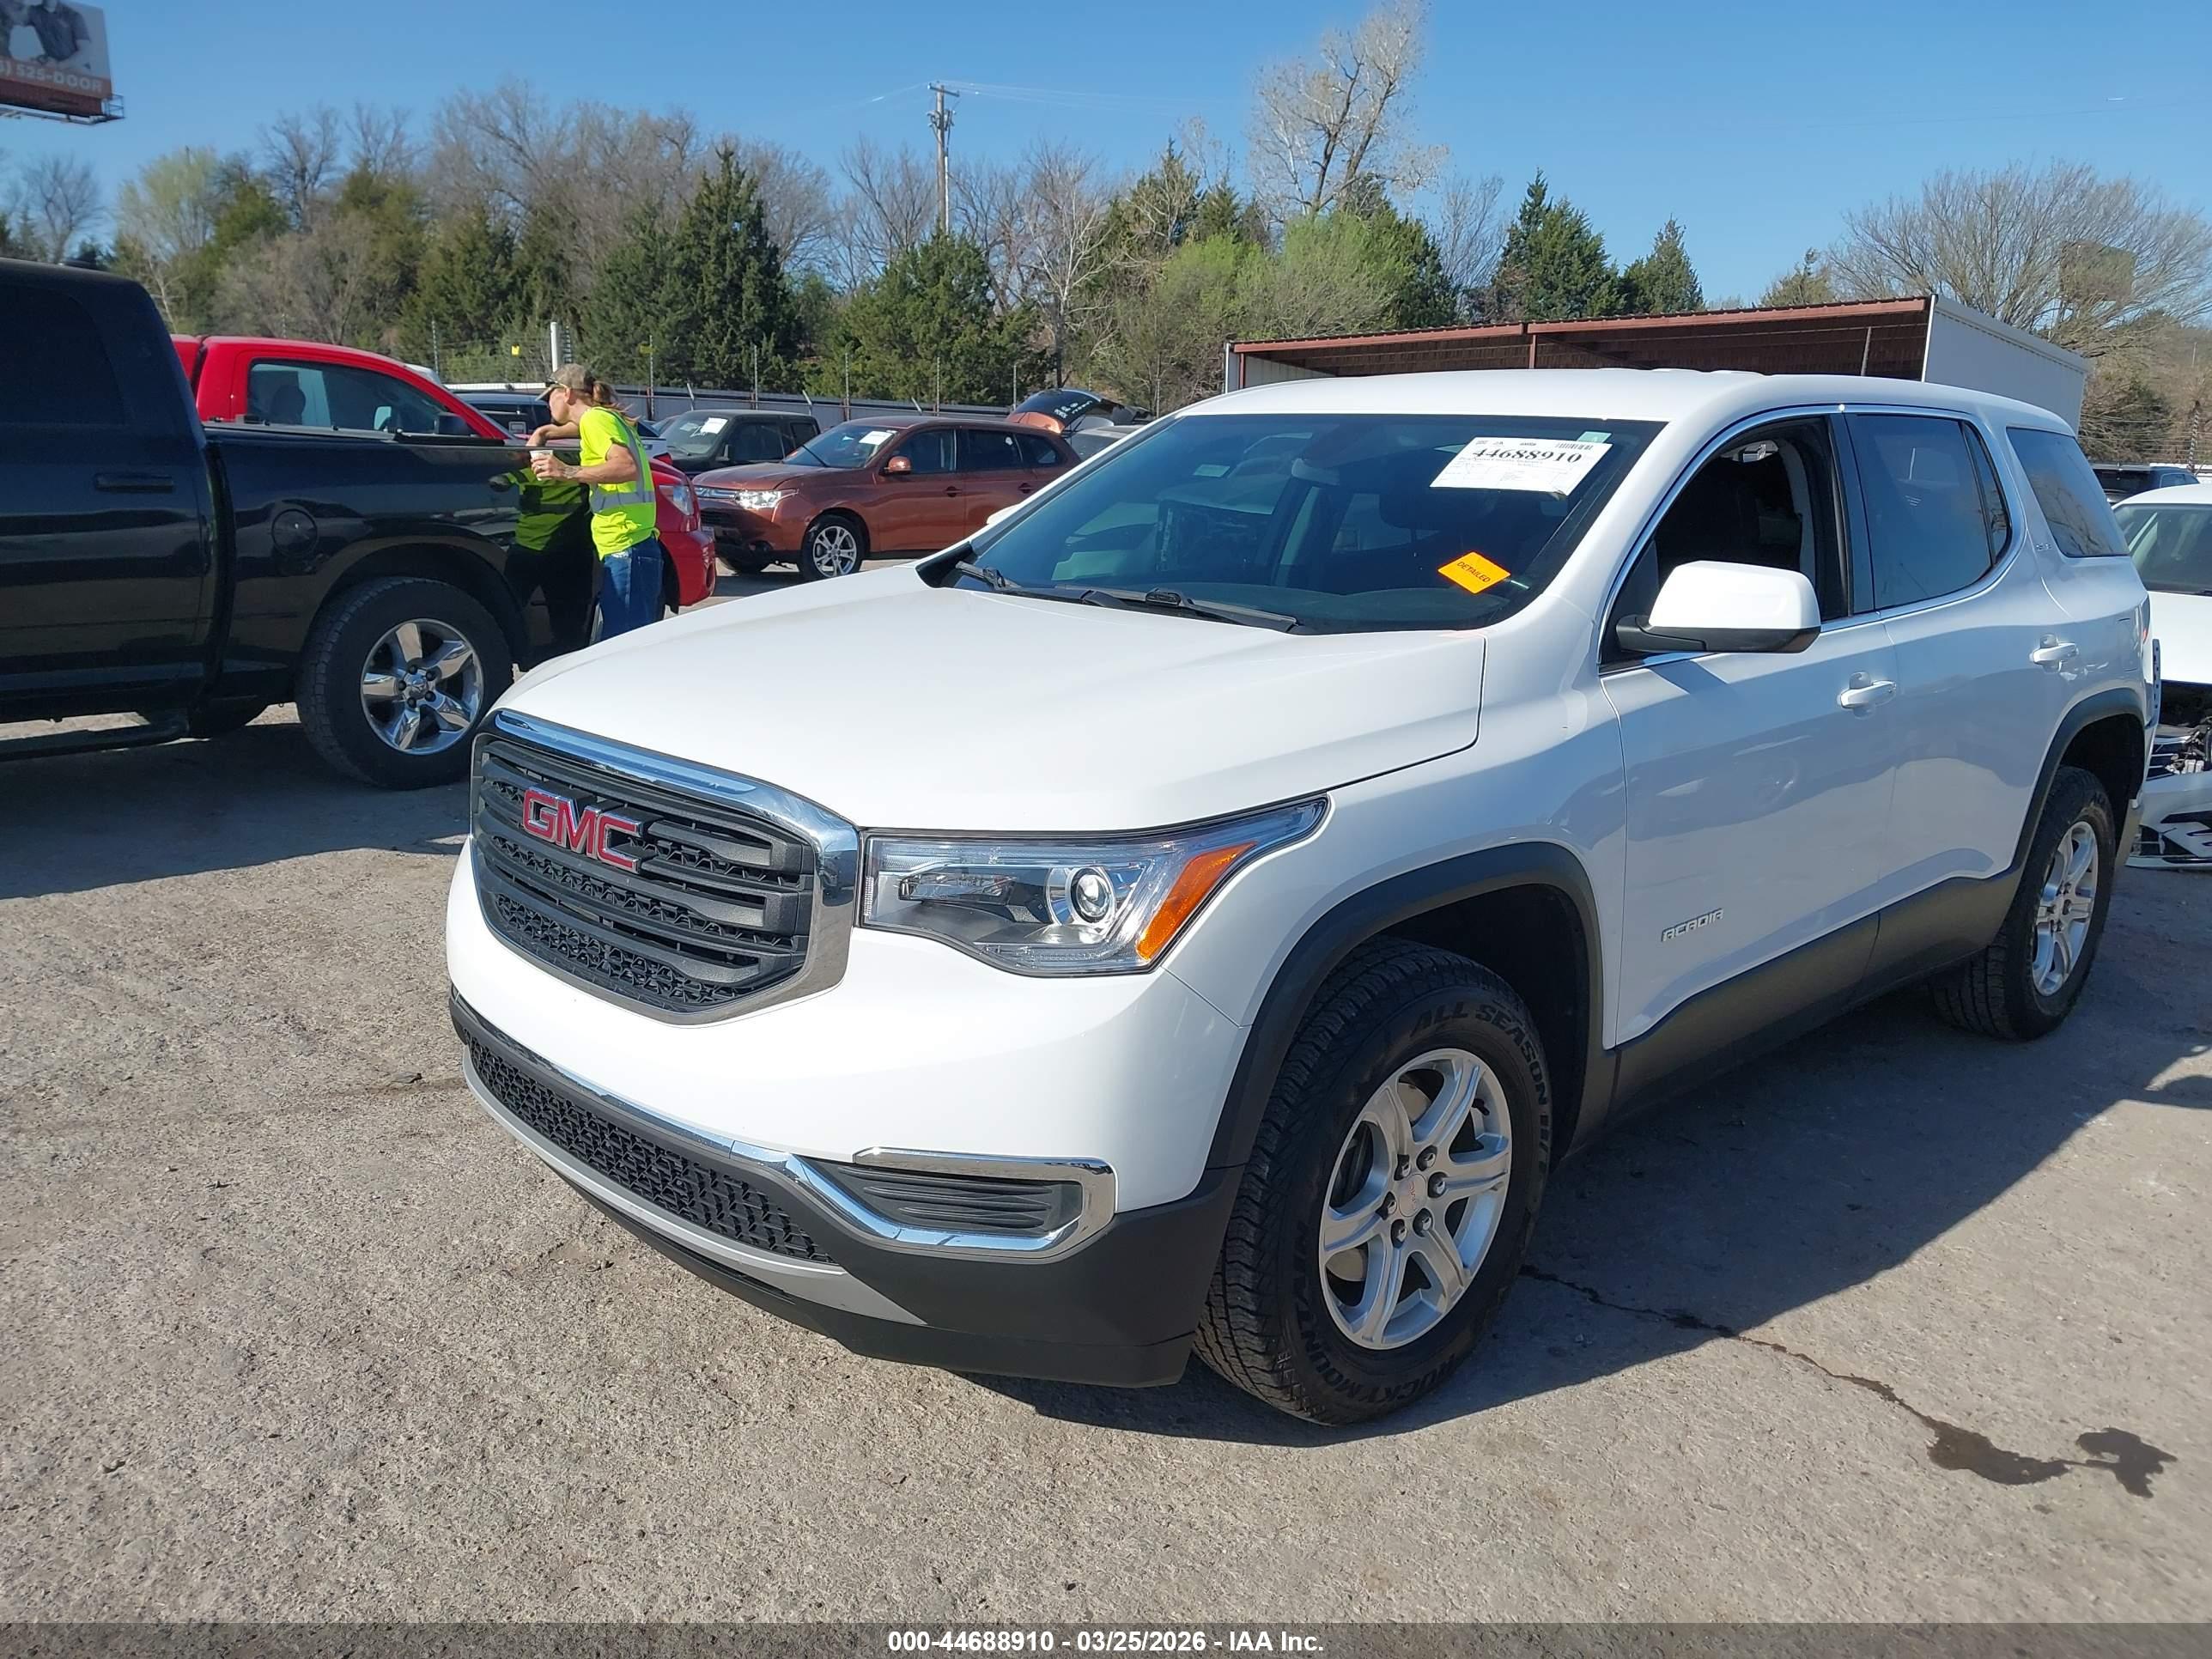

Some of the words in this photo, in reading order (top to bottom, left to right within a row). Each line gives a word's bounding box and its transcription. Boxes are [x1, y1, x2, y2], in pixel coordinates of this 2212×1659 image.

[16, 64, 102, 93] 525-DOOR
[1473, 448, 1582, 463] 44688910
[1457, 562, 1491, 582] DETAILED
[523, 787, 644, 874] GMC
[1661, 908, 1724, 942] ACADIA
[1409, 1001, 1468, 1037] ALL
[1474, 1001, 1547, 1105] SEASON
